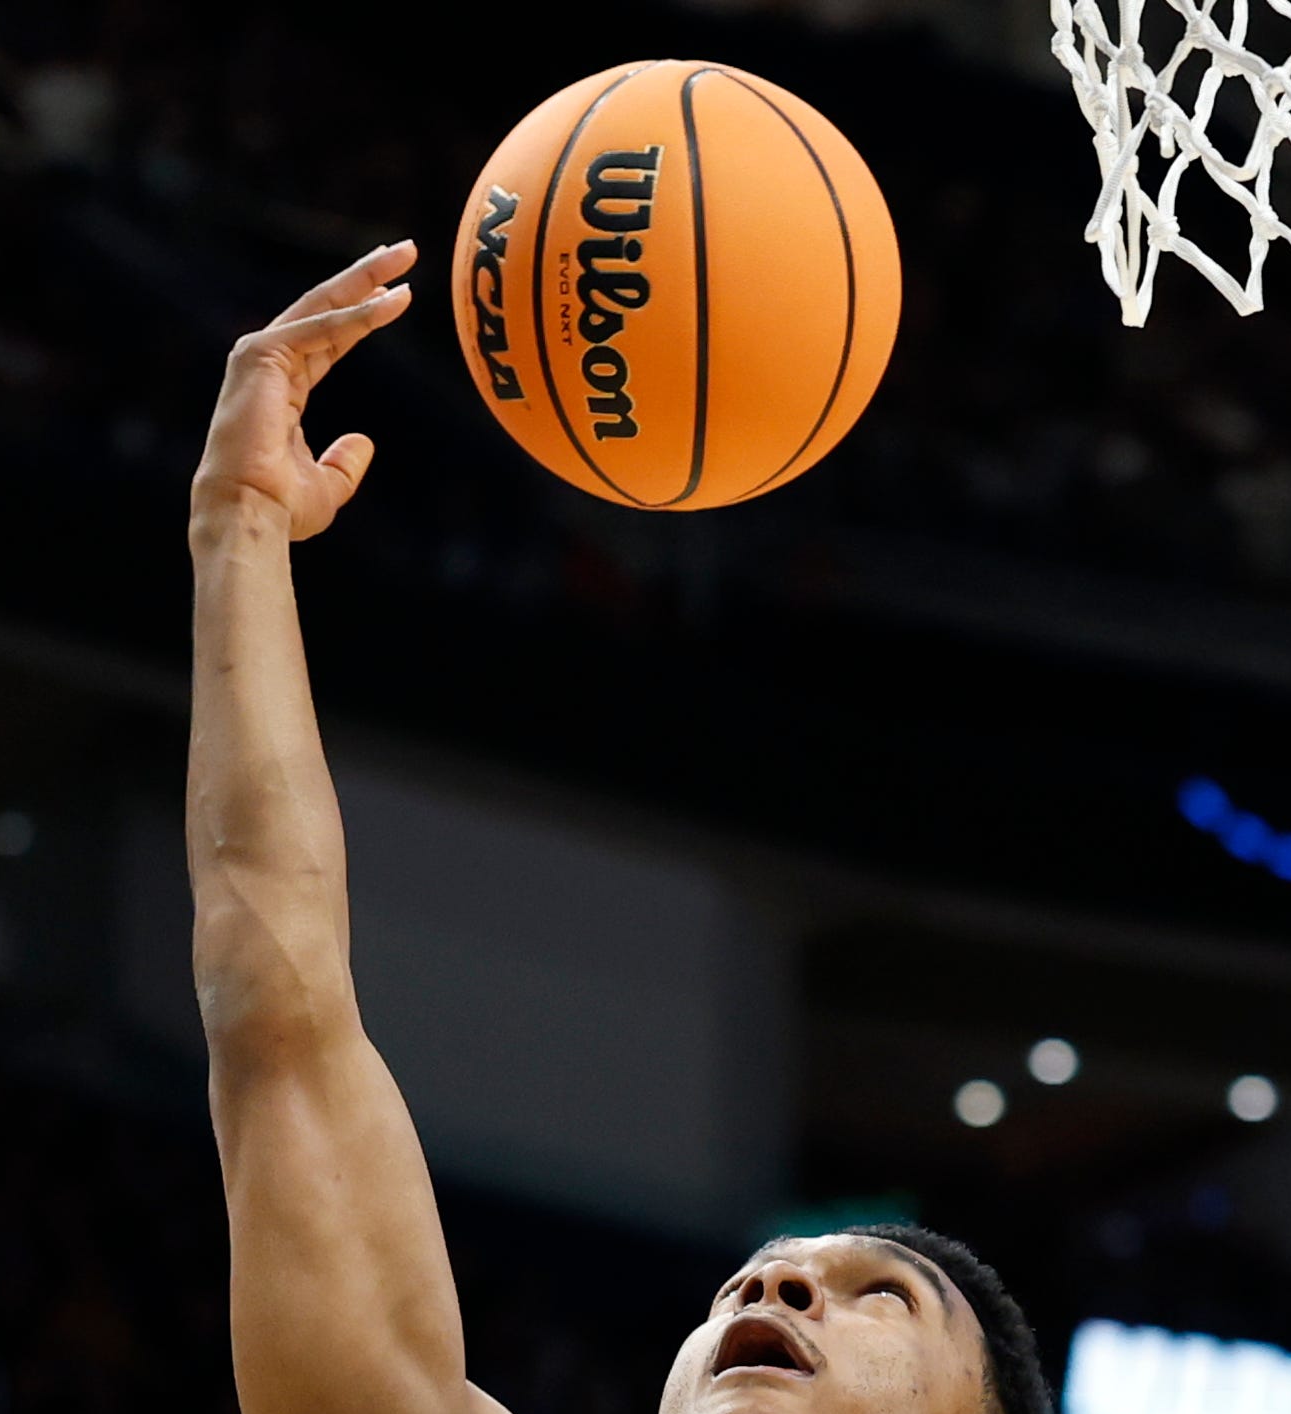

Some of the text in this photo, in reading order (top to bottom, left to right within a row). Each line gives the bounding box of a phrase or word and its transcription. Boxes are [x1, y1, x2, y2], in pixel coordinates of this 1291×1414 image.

[471, 184, 527, 403] NCAA
[557, 252, 574, 346] EVO NXT
[577, 144, 664, 442] Wilson
